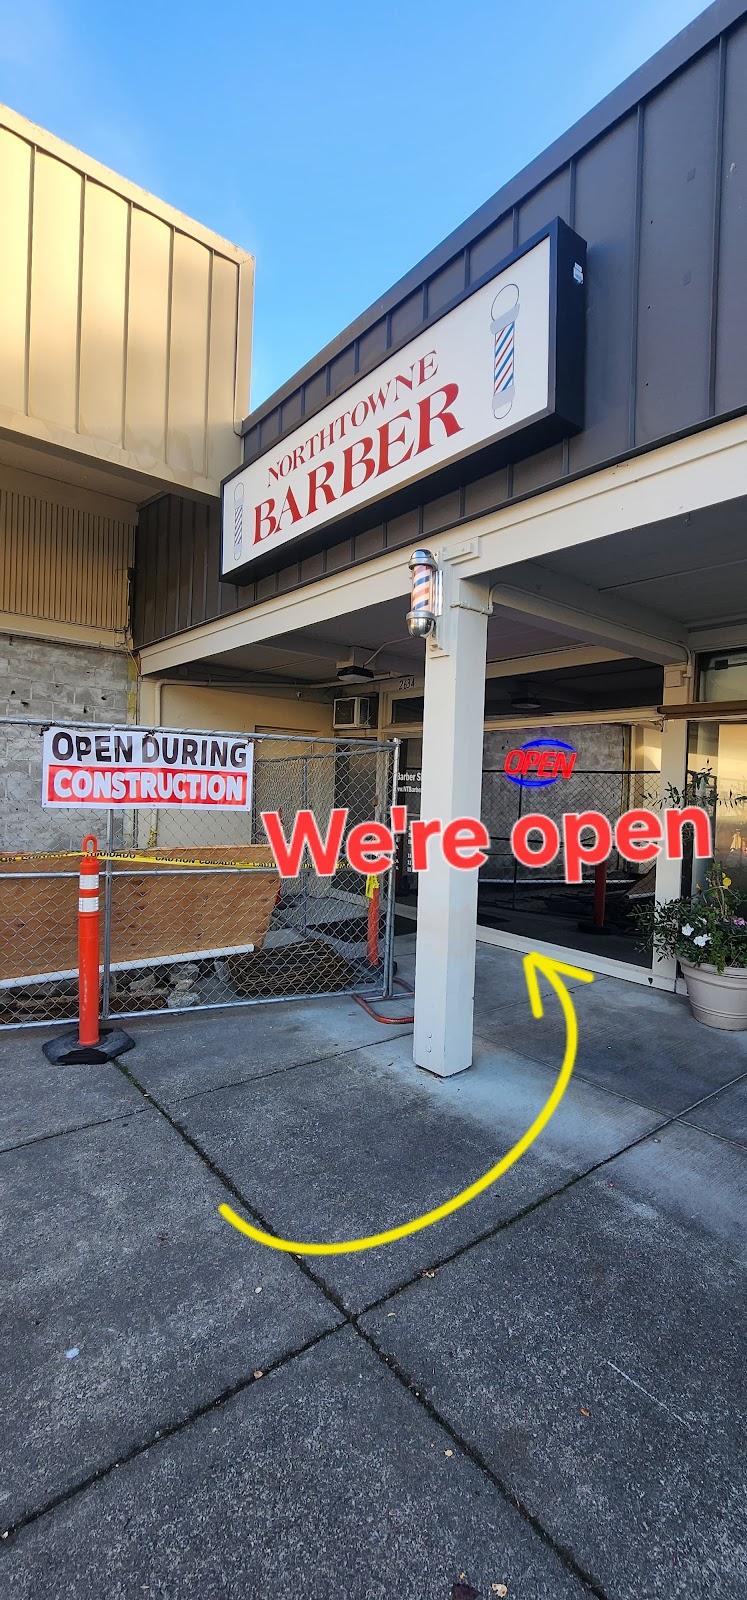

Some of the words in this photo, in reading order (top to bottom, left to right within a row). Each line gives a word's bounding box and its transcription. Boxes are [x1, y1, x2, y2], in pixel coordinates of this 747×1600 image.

[267, 350, 439, 488] NORTHTOWNE
[252, 383, 465, 545] BARBER
[398, 678, 415, 690] 2634
[52, 731, 133, 763] OPEN
[142, 734, 247, 769] DURING
[504, 749, 577, 779] OPEN
[53, 769, 243, 801] CONSTRUCTION
[397, 772, 416, 781] Barber
